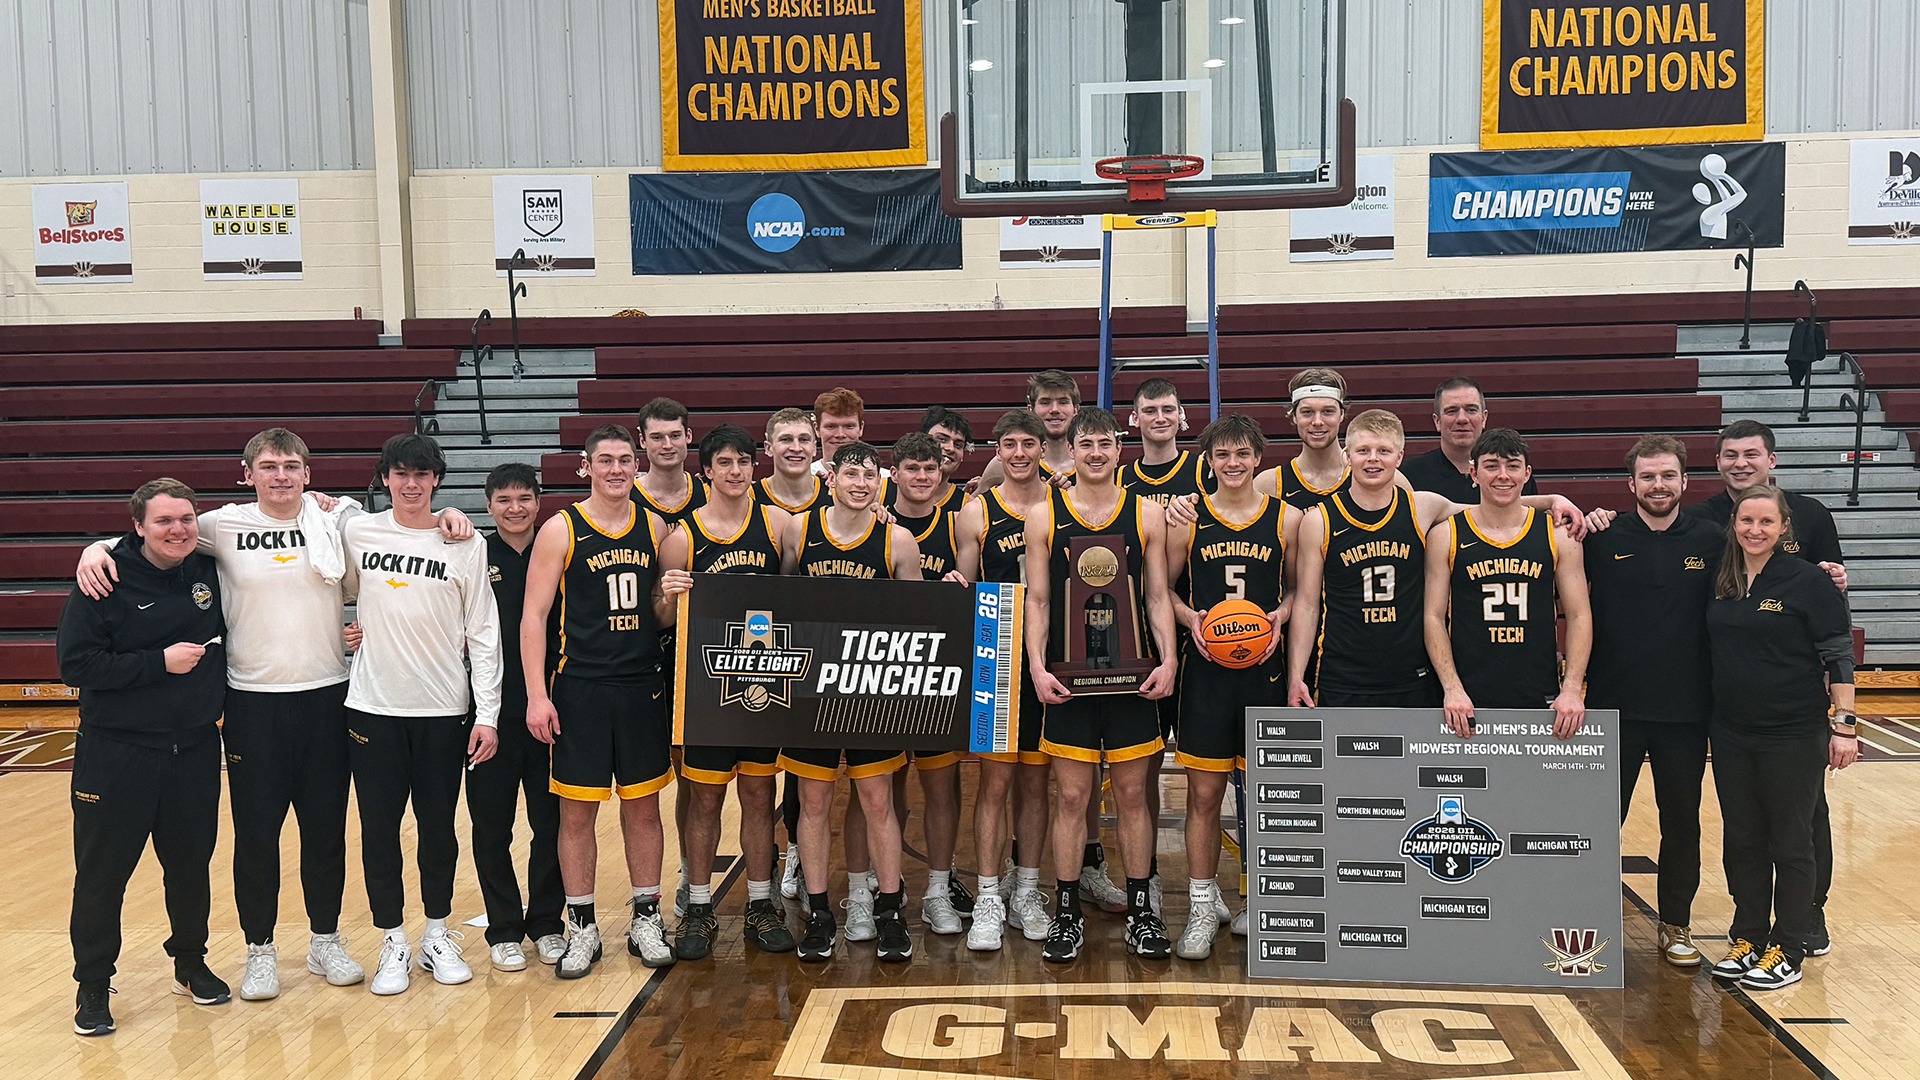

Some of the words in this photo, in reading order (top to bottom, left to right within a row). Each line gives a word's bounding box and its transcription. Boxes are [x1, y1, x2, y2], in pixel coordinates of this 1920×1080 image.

[703, 0, 761, 19] MEN'S
[768, 0, 876, 18] BASKETBALL
[1530, 3, 1717, 48] NATIONAL
[704, 32, 881, 75] NATIONAL
[1509, 49, 1737, 97] CHAMPIONS
[687, 78, 900, 122] CHAMPIONS
[527, 197, 558, 208] SAM
[1452, 187, 1623, 220] CHAMPIONS
[1629, 191, 1654, 200] WIN
[206, 205, 294, 217] WAFFLE
[1625, 201, 1655, 211] HERE
[528, 214, 559, 222] CENTER
[237, 531, 286, 551] LOCK
[1200, 541, 1273, 562] MICHIGAN
[1340, 540, 1411, 568] MICHIGAN
[362, 551, 405, 573] LOCK
[406, 556, 425, 576] IT
[425, 560, 449, 581] IN.
[586, 549, 650, 573] MICHIGAN
[807, 559, 877, 580] MICHIGAN
[1081, 564, 1118, 578] NCAA
[1466, 558, 1543, 581] MICHIGAN
[1224, 565, 1246, 600] 5
[1361, 564, 1396, 603] 13
[606, 572, 638, 611] 10
[978, 592, 998, 620] 26
[1481, 582, 1529, 622] 24
[608, 614, 639, 631] TECH
[1084, 609, 1114, 625] TECH
[1362, 606, 1397, 623] TECH
[982, 623, 992, 642] SEAT
[1212, 621, 1261, 637] Wilson
[1488, 627, 1524, 643] TECH
[841, 630, 946, 663] TICKET
[977, 646, 996, 660] 5
[715, 654, 756, 671] ELITE
[757, 656, 802, 672] EIGHT
[816, 663, 962, 696] PUNCHED
[980, 665, 990, 684] ROW
[1073, 677, 1103, 686] REGIONAL
[1104, 676, 1137, 685] CHAMPION
[975, 690, 994, 705] 4
[977, 712, 989, 747] SECTION
[1258, 722, 1263, 738] 1
[1266, 726, 1286, 736] WALSH
[1476, 725, 1490, 735] DII
[1493, 724, 1528, 735] MEN'S
[1531, 724, 1604, 736] BASBALL
[1353, 742, 1380, 750] WALSH
[1410, 743, 1462, 754] MIDWEST
[1464, 744, 1522, 755] REGIONAL
[1525, 744, 1604, 756] TOURNAMENT
[1259, 749, 1265, 765] 8
[1266, 754, 1292, 762] WILLIAM
[1292, 754, 1312, 763] JEWELL
[1436, 774, 1463, 783] WALSH
[1260, 785, 1266, 801] 4
[1268, 790, 1300, 799] ROCKHURST
[1338, 806, 1371, 815] NORTHERN
[1372, 808, 1404, 816] MICHIGAN
[1260, 814, 1266, 830] 5
[1268, 818, 1292, 827] NORTHERN
[1293, 819, 1317, 827] MICHIGAN
[1403, 841, 1500, 856] CHAMPIONSHIP
[1526, 840, 1568, 850] MICHIGAN
[1569, 840, 1590, 850] TECH
[1260, 849, 1266, 864] 2
[1338, 868, 1361, 876] GRAND
[1362, 869, 1384, 878] VALLEY
[1385, 870, 1402, 878] STATE
[1260, 877, 1266, 892] 7
[1268, 882, 1295, 890] ASHLAND
[1424, 903, 1464, 914] MICHIGAN
[1467, 904, 1486, 914] TECH
[1262, 913, 1267, 929] 3
[1270, 918, 1298, 927] MICHIGAN
[1300, 918, 1314, 928] TECH
[1341, 932, 1381, 942] MICHIGAN
[1383, 934, 1402, 943] TECH
[1262, 942, 1268, 958] 6
[1270, 946, 1284, 955] LAKE
[1285, 947, 1296, 956] ERIE
